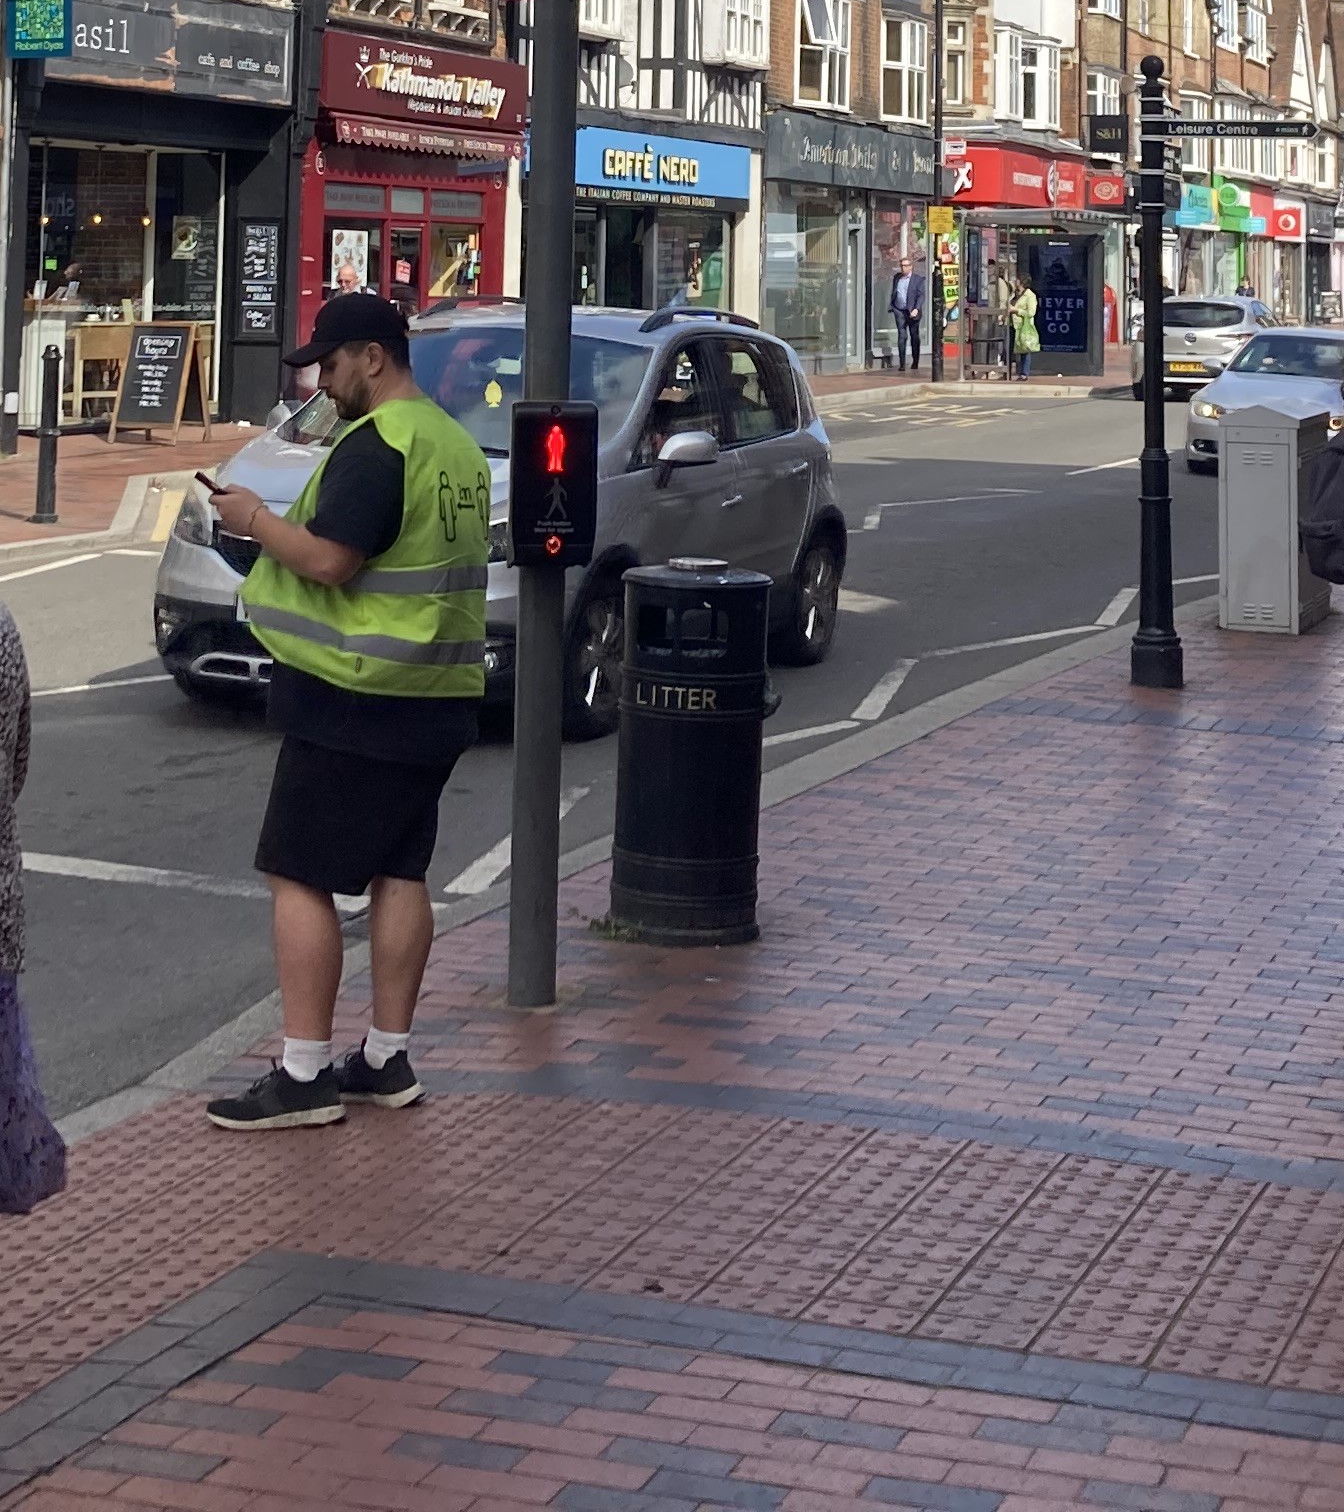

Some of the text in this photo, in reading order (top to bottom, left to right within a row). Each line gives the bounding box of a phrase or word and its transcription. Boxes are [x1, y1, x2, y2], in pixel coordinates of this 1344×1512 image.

[15, 40, 64, 51] Robert Dyas
[74, 19, 130, 55] asil
[381, 63, 506, 121] Kathmandu Valley
[1167, 123, 1213, 135] Leisure
[1216, 123, 1259, 136] Centre
[604, 143, 700, 185] CAFFÈ NERO
[588, 187, 609, 200] ITALIAN
[611, 189, 632, 202] COFFEE
[633, 191, 658, 204] COMPANY
[660, 194, 671, 205] AND
[1045, 310, 1073, 322] LET
[1047, 322, 1070, 334] GO
[636, 682, 717, 711] LITTER
